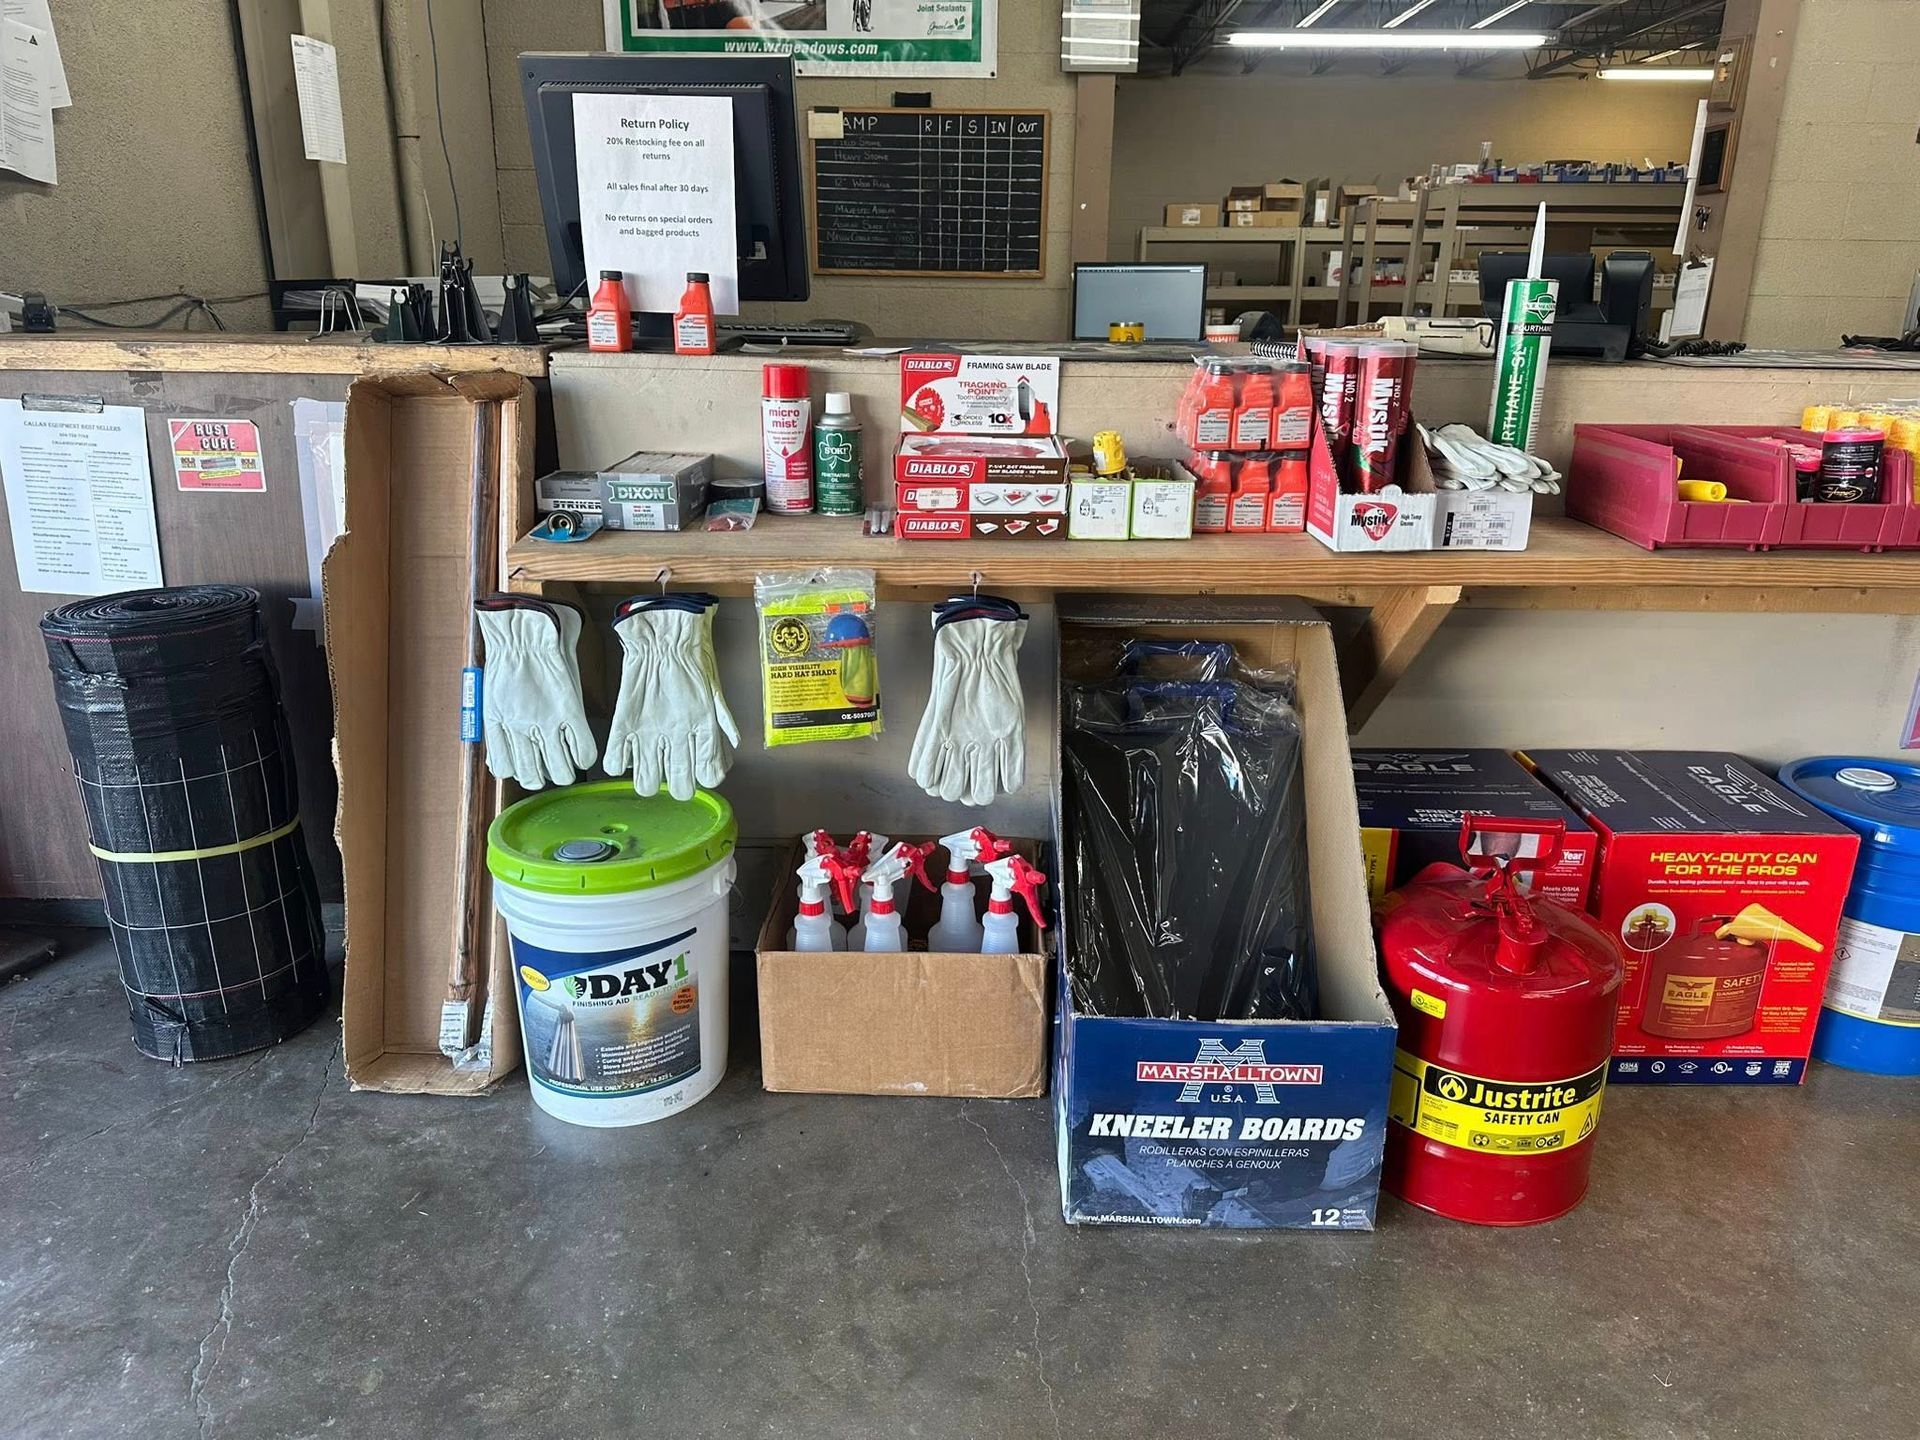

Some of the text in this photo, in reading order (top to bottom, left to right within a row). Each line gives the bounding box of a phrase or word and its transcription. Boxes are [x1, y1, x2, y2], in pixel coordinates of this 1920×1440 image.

[936, 4, 966, 12] Sealants
[724, 40, 878, 56] www.wrmeadows.com
[621, 118, 690, 131] Return Policy
[843, 116, 878, 131] AMP
[925, 121, 933, 132] R
[945, 121, 952, 132] F
[968, 120, 977, 134] S
[991, 121, 1006, 133] IN
[1017, 122, 1038, 133] OUT
[606, 137, 624, 146] 20%
[625, 138, 667, 148] Restocking
[668, 138, 681, 147] fee
[695, 139, 705, 147] all
[606, 182, 709, 194] All sales final after 30 days
[660, 216, 686, 225] special
[688, 216, 713, 224] orders
[636, 228, 664, 237] bagged
[665, 229, 700, 239] products
[908, 361, 942, 369] DIABLO
[769, 407, 800, 417] micro
[1368, 378, 1394, 453] Mystik
[48, 421, 80, 429] EQUIPMENT
[772, 418, 797, 428] mist
[195, 424, 229, 437] RUST
[201, 438, 237, 451] CURE
[910, 464, 957, 474] DIABLO
[618, 489, 665, 500] DIXON
[553, 501, 602, 510] STRIKER
[908, 521, 948, 530] DIABLO
[1351, 514, 1388, 527] Mystik
[1687, 766, 1769, 813] EAGLE
[1563, 851, 1582, 860] Year
[1650, 852, 1817, 864] HEAVY-DUTY CAN
[1665, 865, 1798, 876] FOR THE PROS
[589, 953, 689, 1000] DAY1
[573, 1000, 614, 1008] FINISHING
[632, 979, 688, 1001] READY-TO-USE
[1668, 990, 1708, 999] EAGLE
[621, 1060, 643, 1068] surface
[632, 1062, 657, 1072] abrasion
[1141, 1065, 1318, 1082] MARSHALLTOWN
[549, 1079, 589, 1091] PROFESSIONAL
[1211, 1094, 1247, 1103] U.S.A.
[1470, 1083, 1576, 1110] Justrite
[1484, 1111, 1560, 1125] SAFETY CAN
[1089, 1114, 1365, 1141] KNEELER BOARDS
[1139, 1145, 1309, 1158] RODILLERAS CON ESPINILLERAS
[1166, 1157, 1224, 1168] PLANCHES
[1236, 1159, 1281, 1169] GENOUX
[1311, 1208, 1340, 1226] 12
